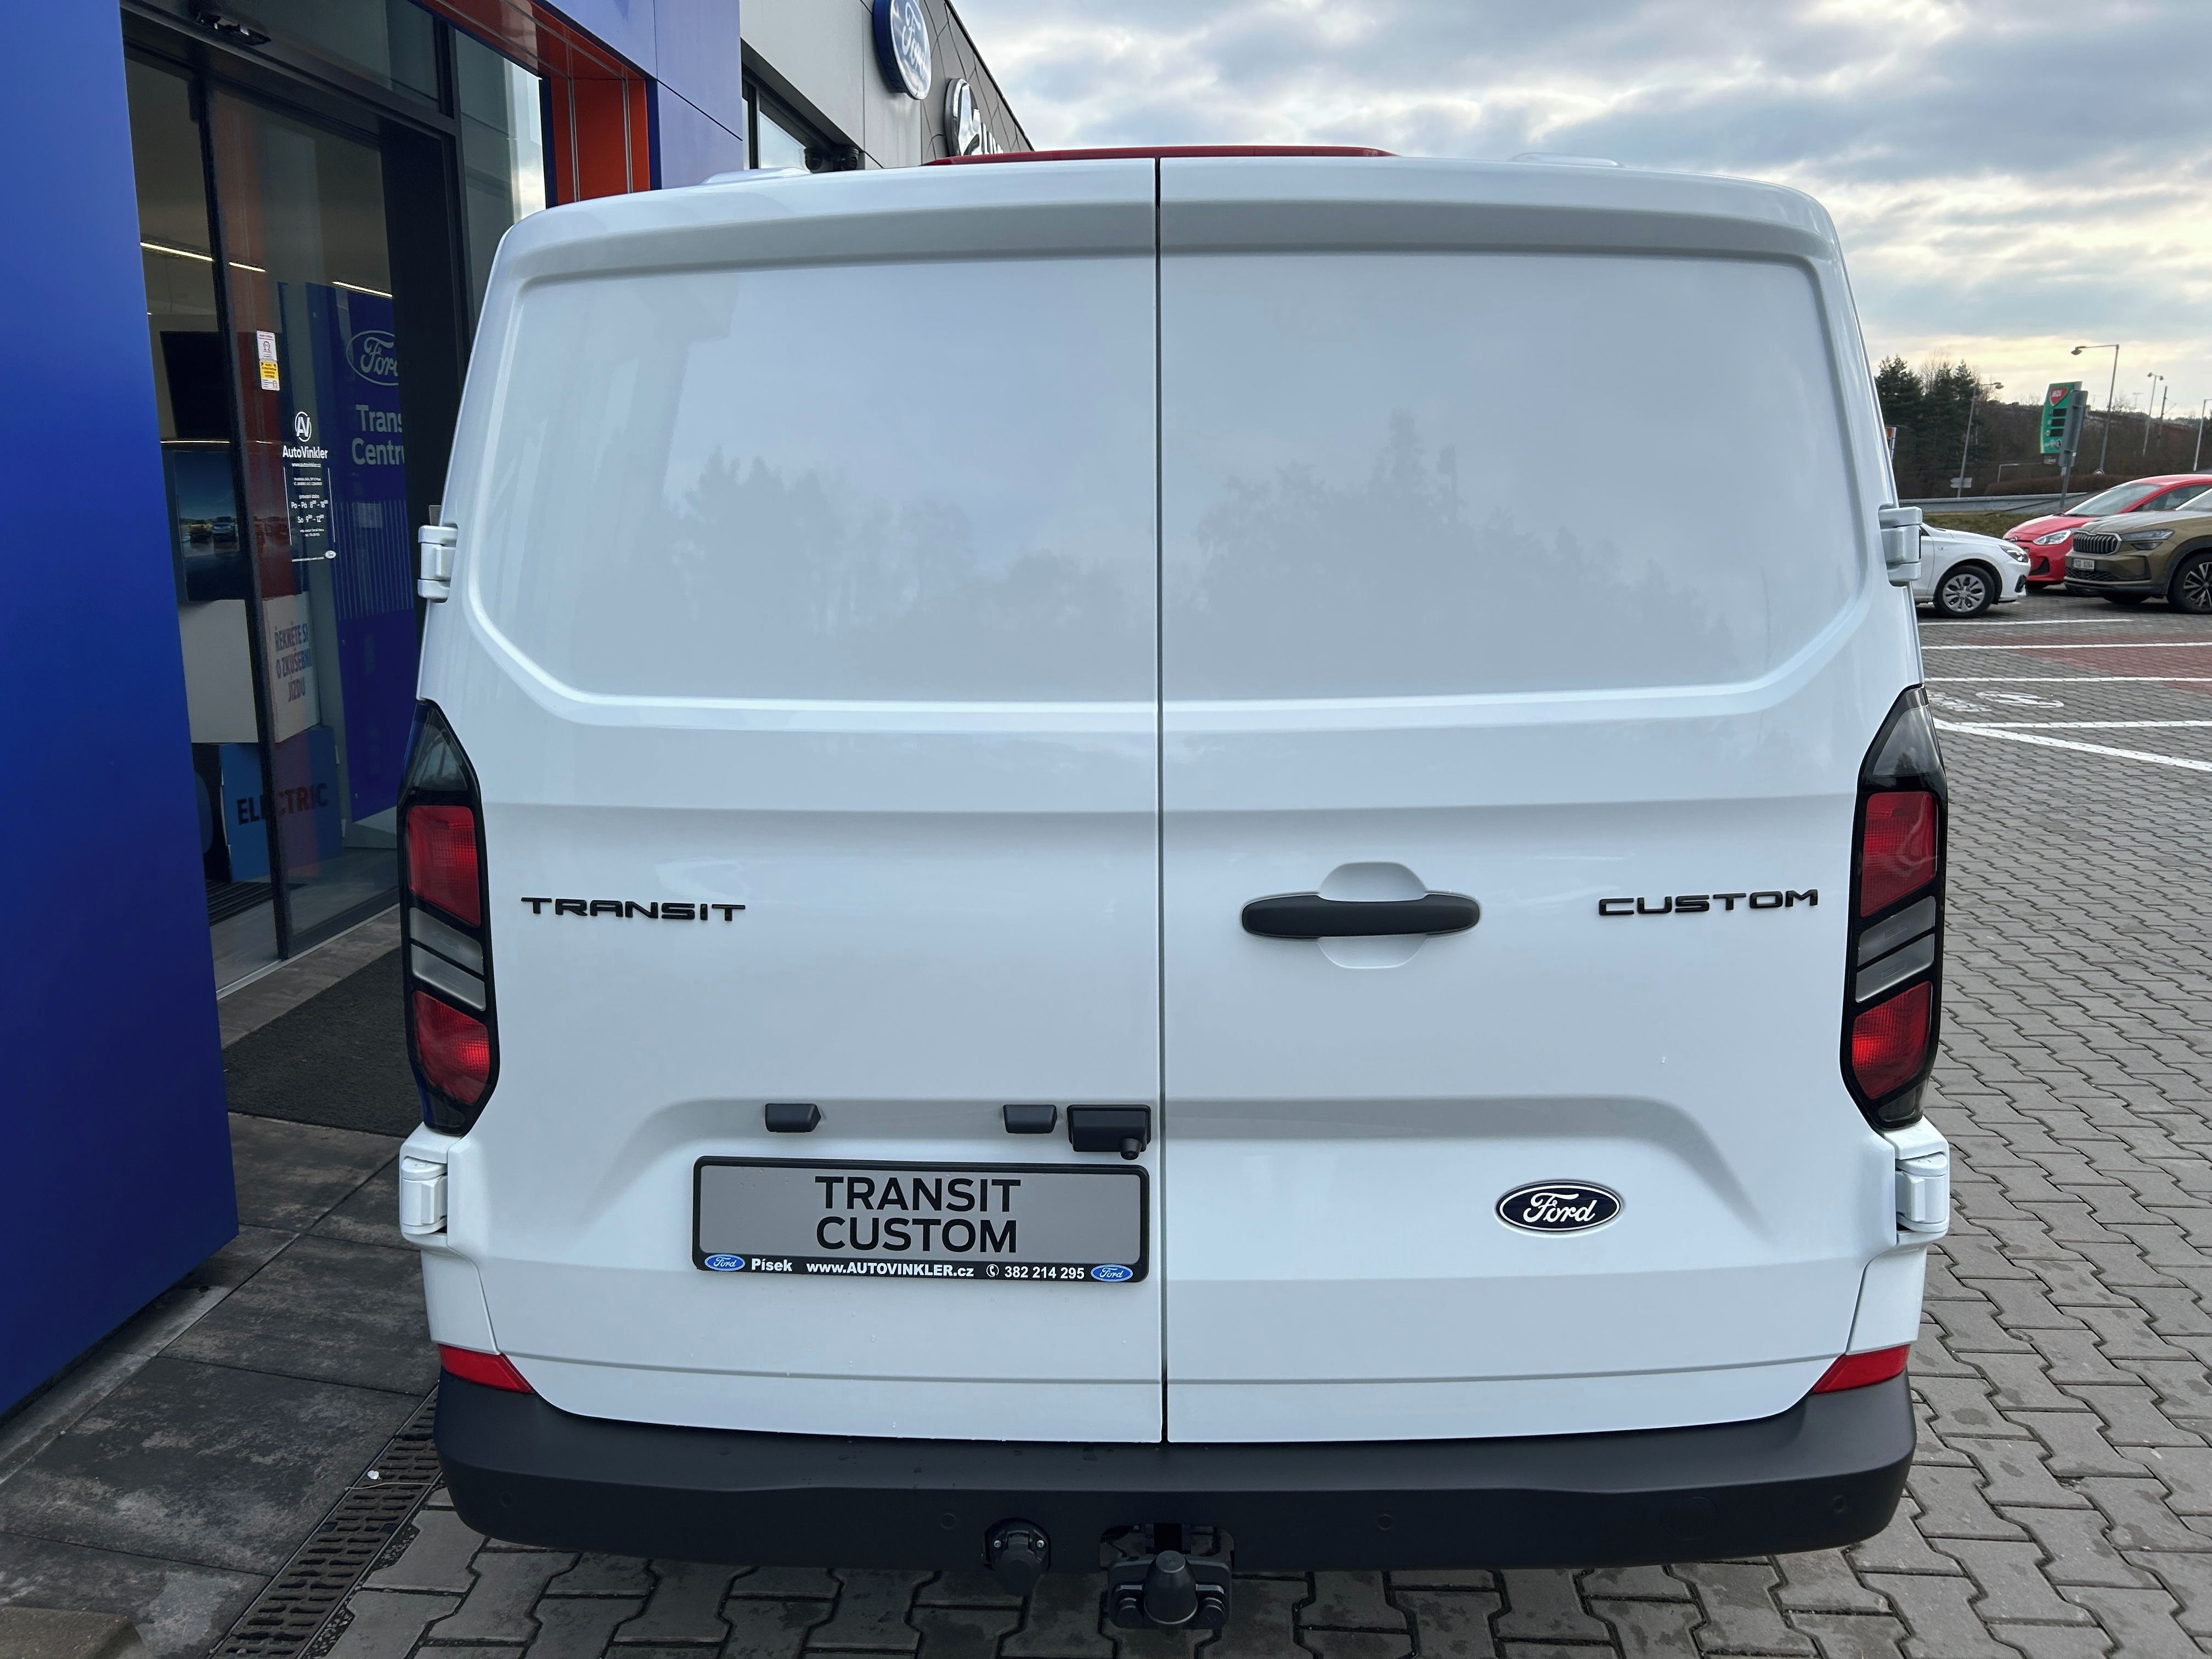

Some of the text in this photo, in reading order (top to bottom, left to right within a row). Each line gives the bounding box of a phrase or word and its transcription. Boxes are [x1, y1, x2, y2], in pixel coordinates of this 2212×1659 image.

[283, 445, 328, 459] AutoVinkler
[352, 438, 405, 465] Centr
[276, 658, 281, 679] O
[521, 897, 746, 921] TRANSIT
[1599, 889, 1818, 916] CUSTOM
[815, 1176, 1022, 1212] TRANSIT
[1523, 1192, 1598, 1223] Ford
[816, 1216, 1017, 1254] CUSTOM
[751, 1258, 793, 1272] Písek
[806, 1262, 974, 1277] www.AUTOVINKLER.cz
[1005, 1265, 1029, 1279] 382
[1032, 1266, 1057, 1279] 214
[1060, 1266, 1085, 1279] 295
